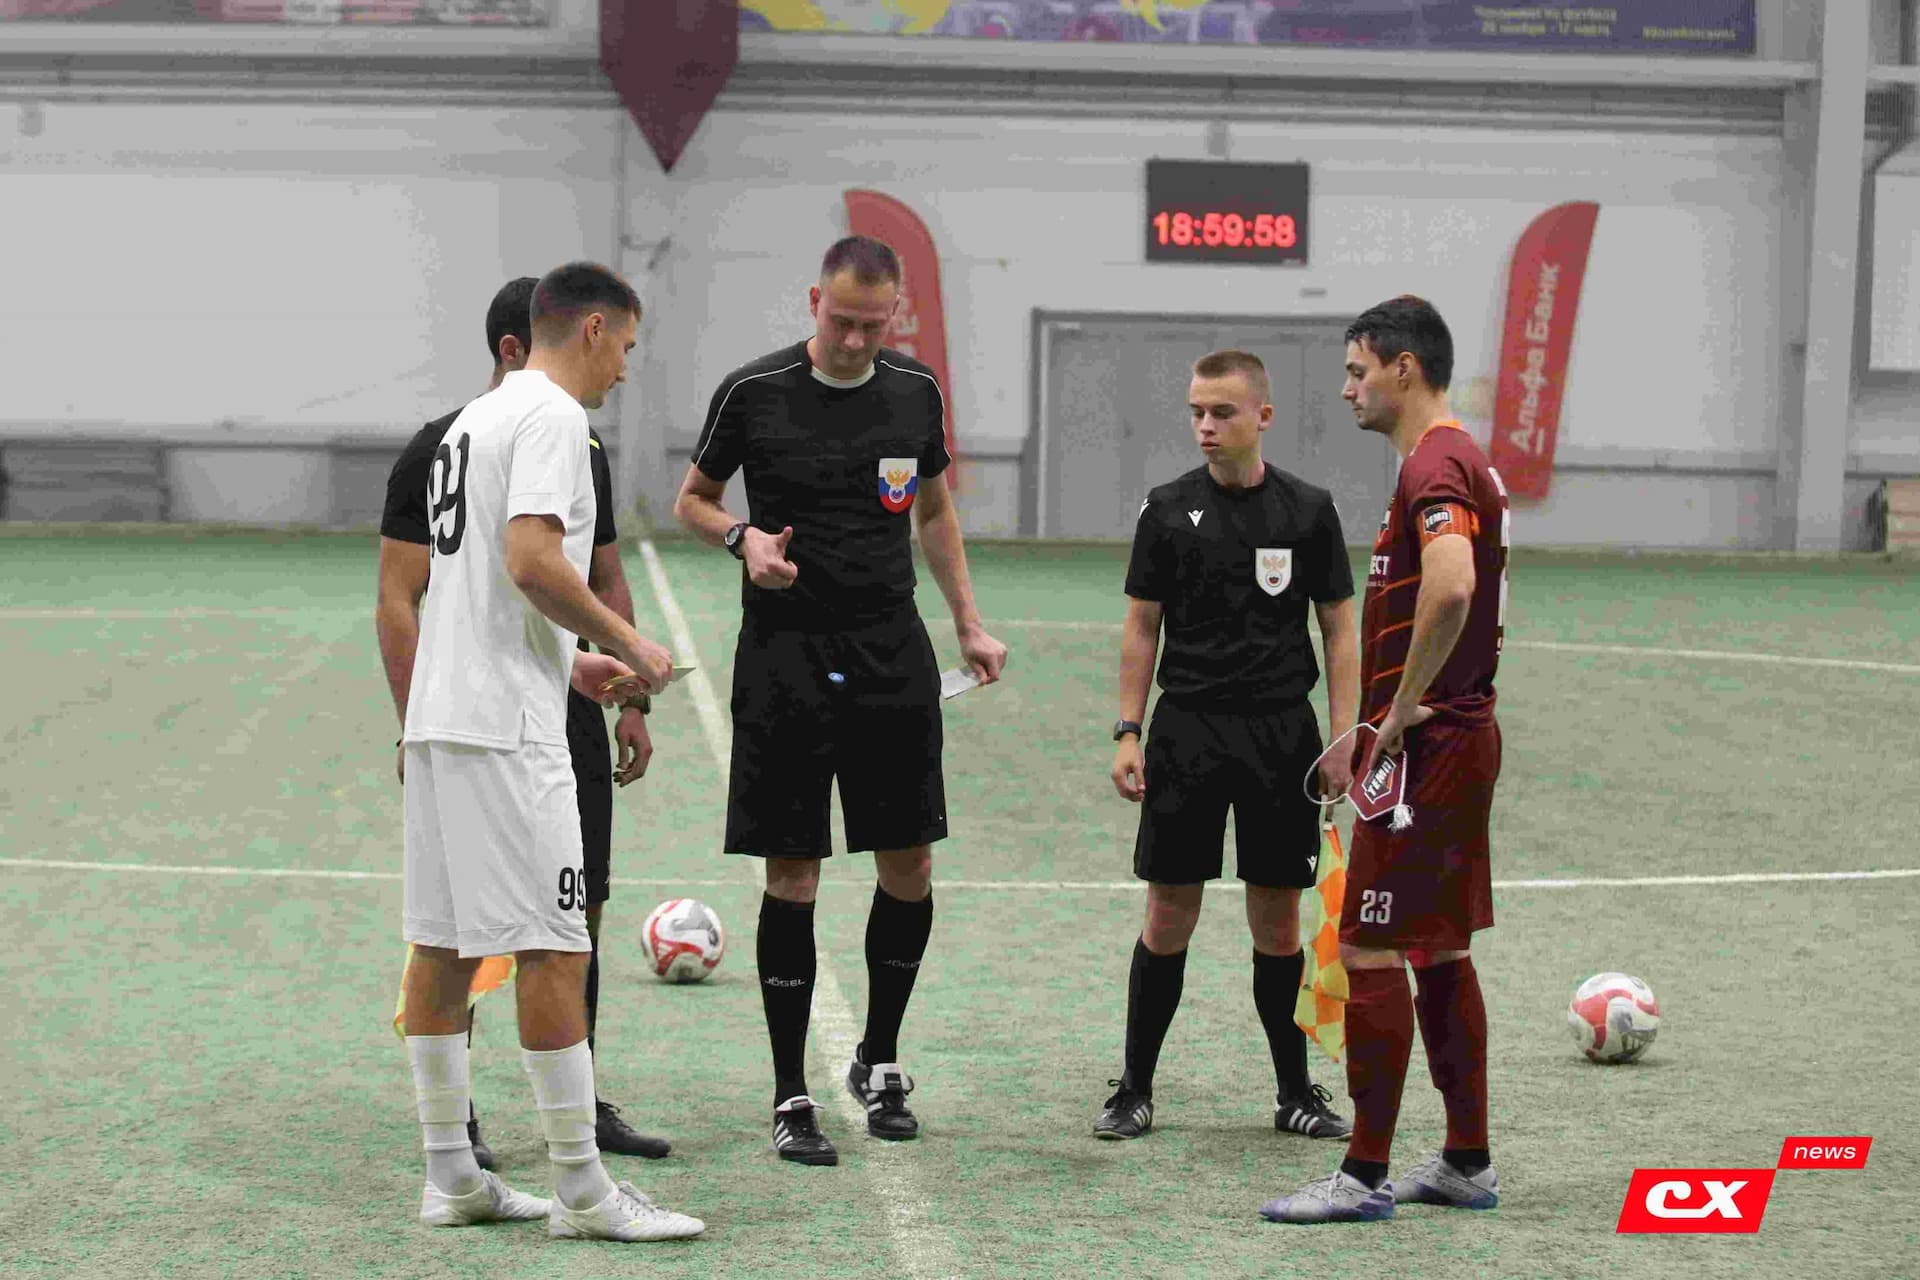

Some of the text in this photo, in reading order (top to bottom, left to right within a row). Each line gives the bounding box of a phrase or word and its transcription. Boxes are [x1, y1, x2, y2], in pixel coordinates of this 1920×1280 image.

[1153, 211, 1297, 248] 18:59:58
[1510, 261, 1561, 452] Альфа Банк
[1367, 760, 1394, 797] ТЕМП
[558, 867, 586, 912] 99
[1360, 889, 1393, 924] 23
